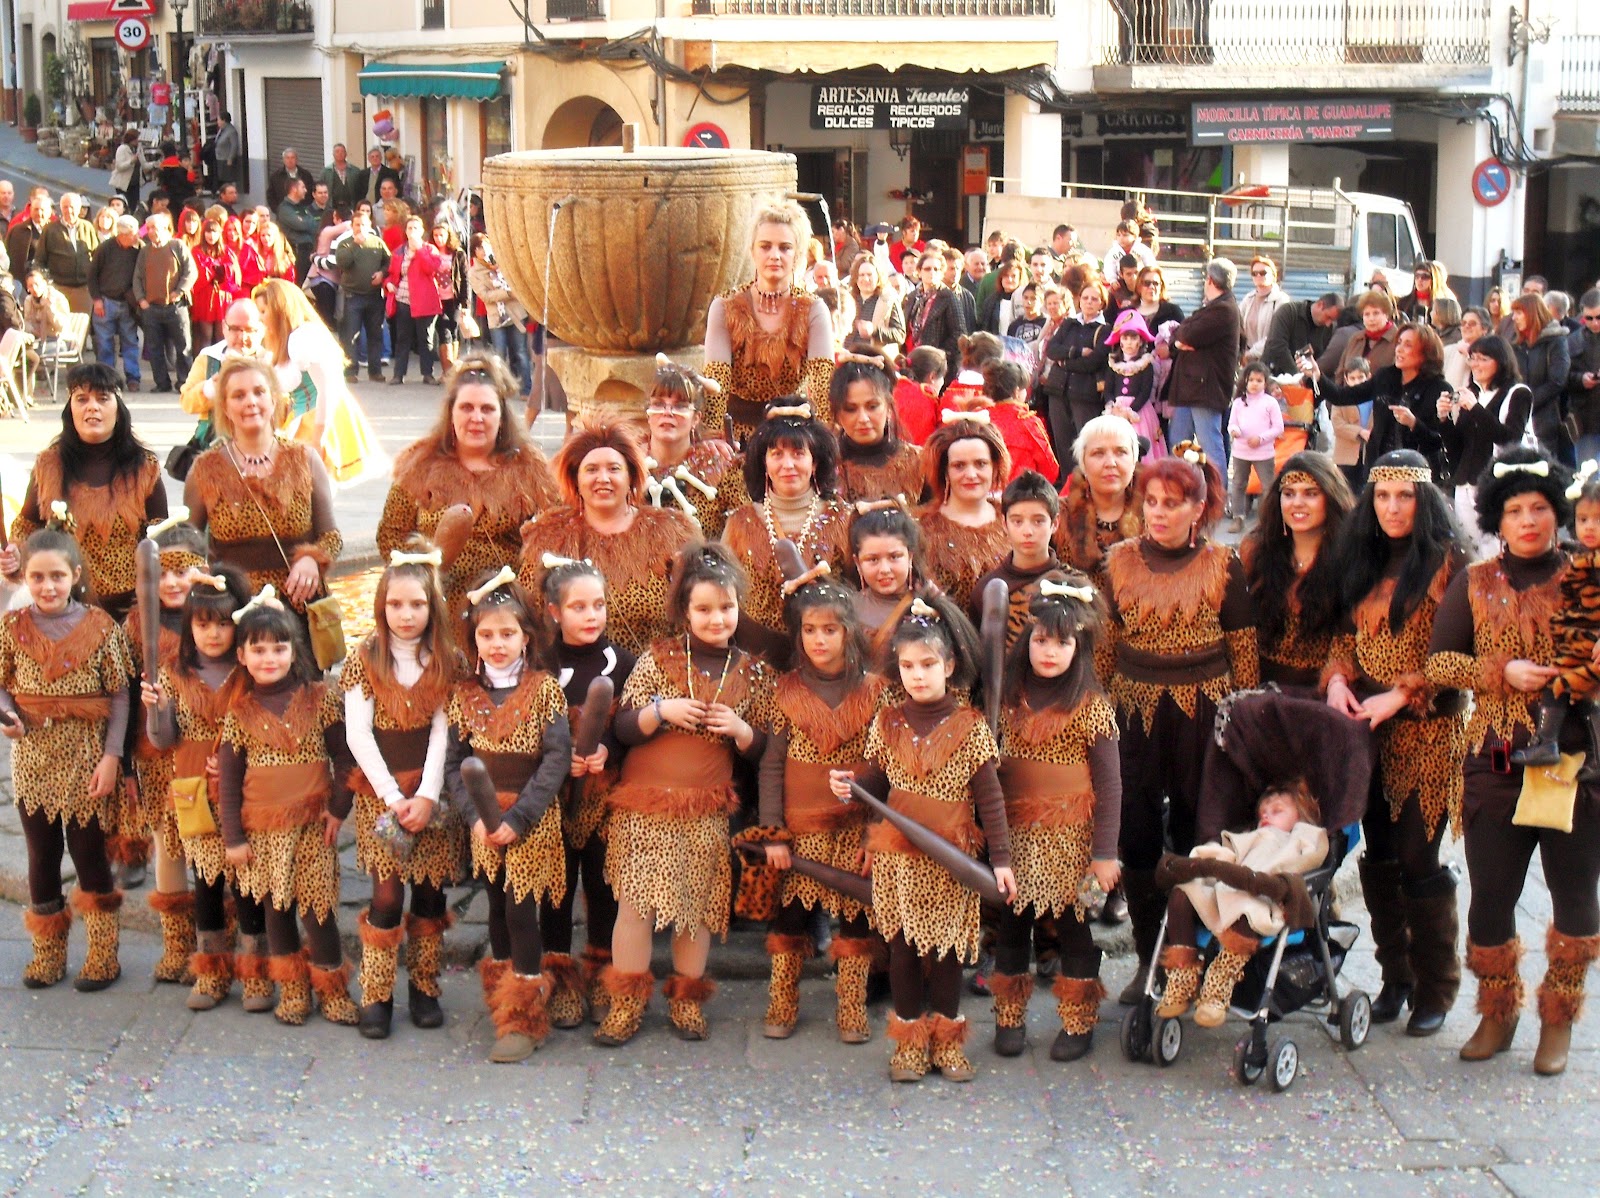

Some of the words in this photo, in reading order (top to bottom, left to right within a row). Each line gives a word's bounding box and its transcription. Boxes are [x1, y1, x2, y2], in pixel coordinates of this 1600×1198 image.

[123, 26, 142, 38] 30
[818, 86, 900, 103] ARTESANIA
[817, 104, 875, 116] REGALOS
[890, 104, 962, 116] RECUERDOS
[1197, 105, 1260, 123] MORCILLA
[1262, 104, 1301, 121] TÍPICA
[1304, 105, 1320, 120] DE
[1322, 104, 1392, 120] GUADALUPE
[824, 117, 874, 128] DULCES
[890, 117, 935, 128] TIPICOS
[1227, 125, 1304, 142] CARNICERÍA
